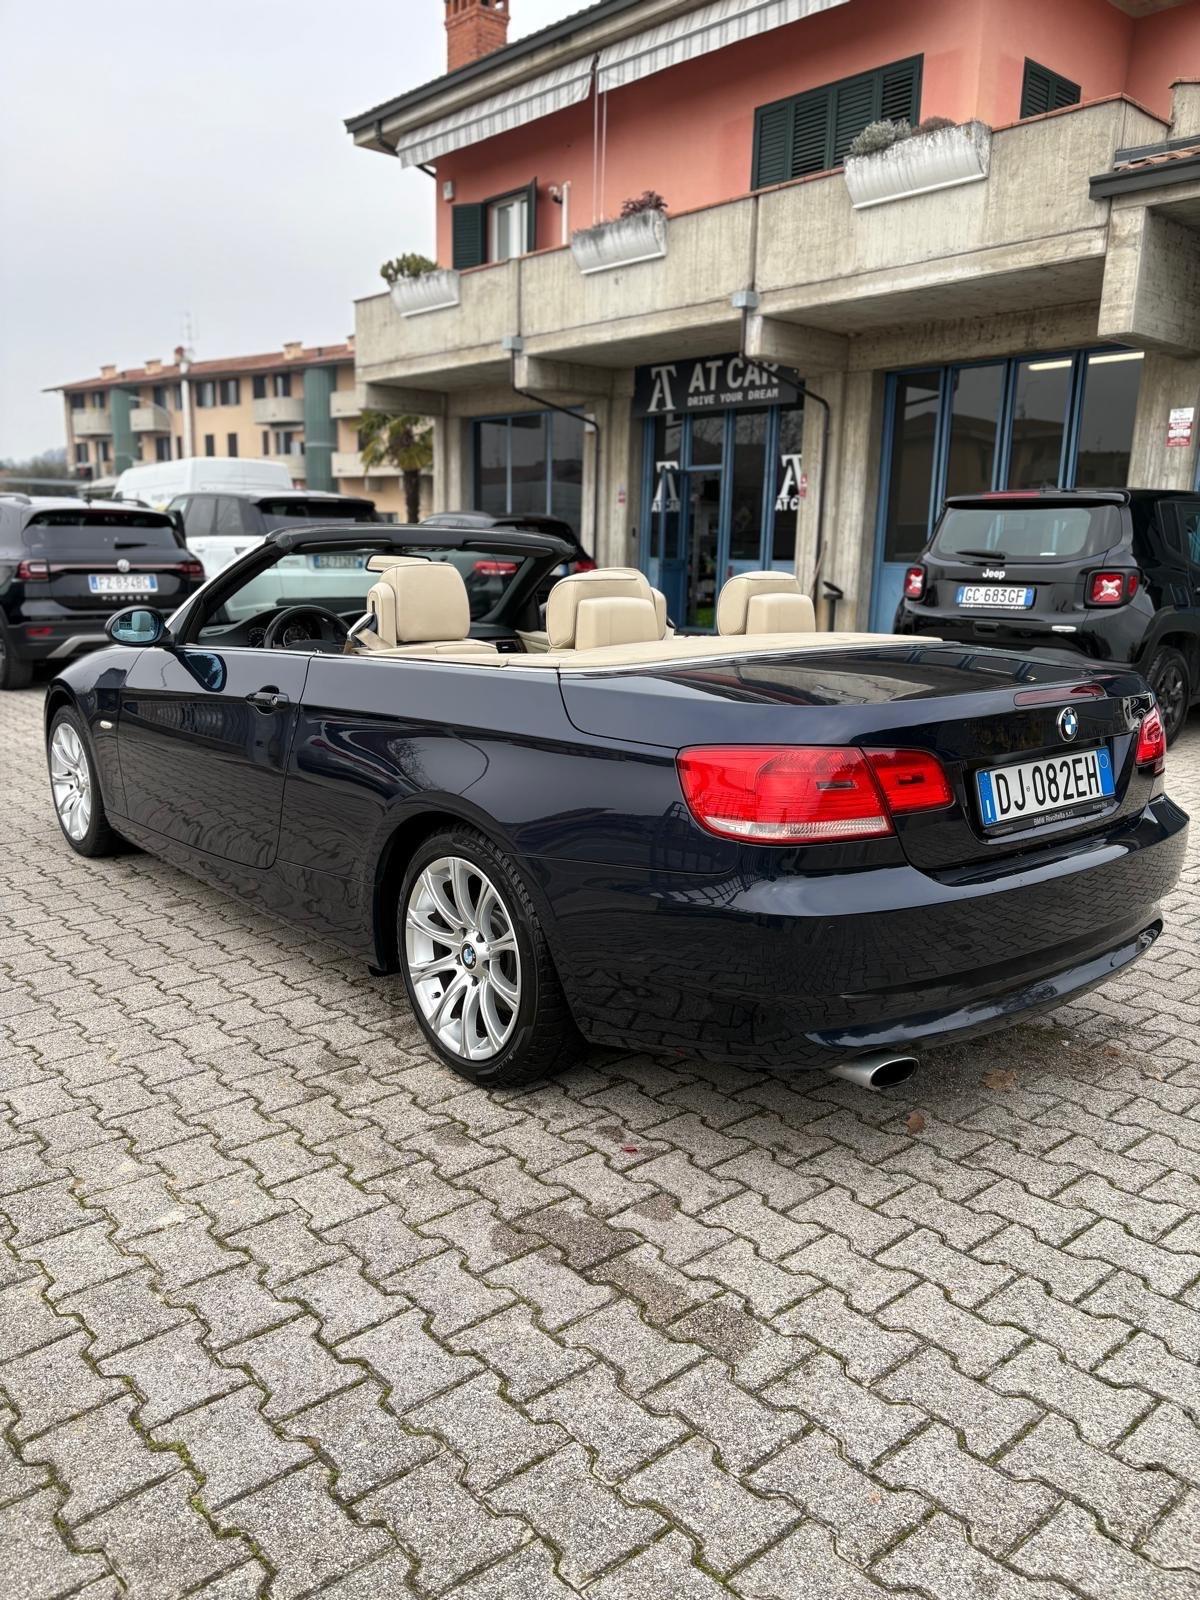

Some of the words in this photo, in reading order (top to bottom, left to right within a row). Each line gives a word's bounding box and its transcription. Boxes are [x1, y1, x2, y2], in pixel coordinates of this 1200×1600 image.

[688, 360, 723, 393] AT
[687, 394, 715, 406] DRIVE
[720, 391, 744, 403] YOUR
[747, 388, 779, 401] DREAM
[775, 498, 789, 511] AT
[982, 568, 1006, 580] Jeep
